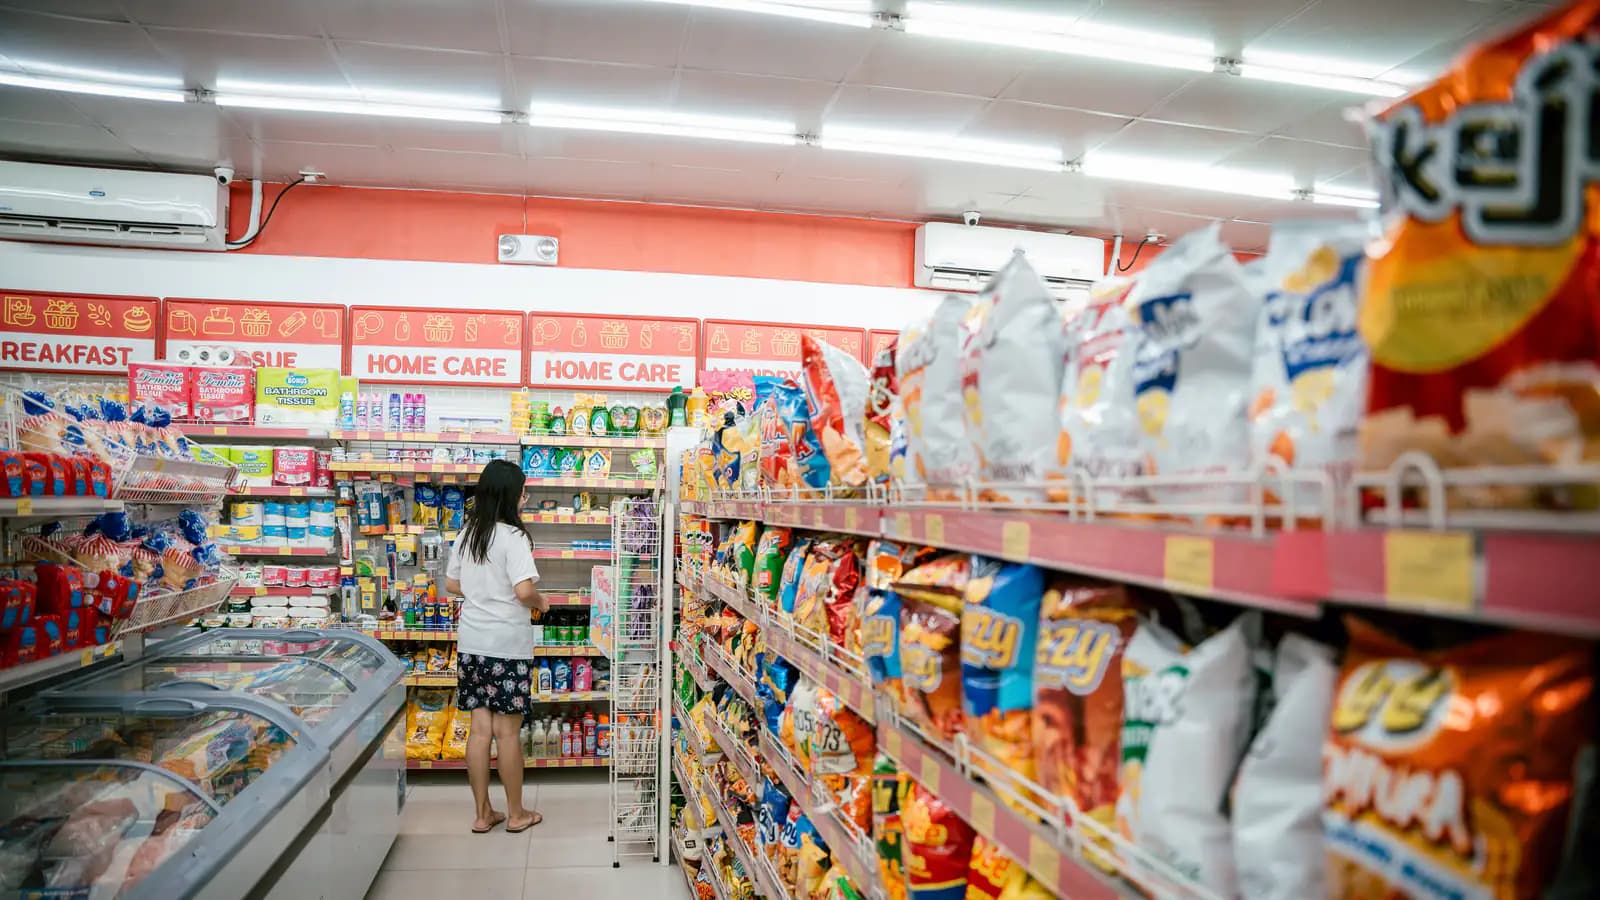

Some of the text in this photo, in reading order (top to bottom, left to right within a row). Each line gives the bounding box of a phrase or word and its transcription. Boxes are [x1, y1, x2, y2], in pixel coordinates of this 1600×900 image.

[367, 354, 507, 377] HOME CARE
[544, 360, 680, 382] HOME CARE
[136, 384, 182, 392] BATHROOM
[264, 387, 328, 396] BATHROOM
[277, 397, 316, 405] TISSUE
